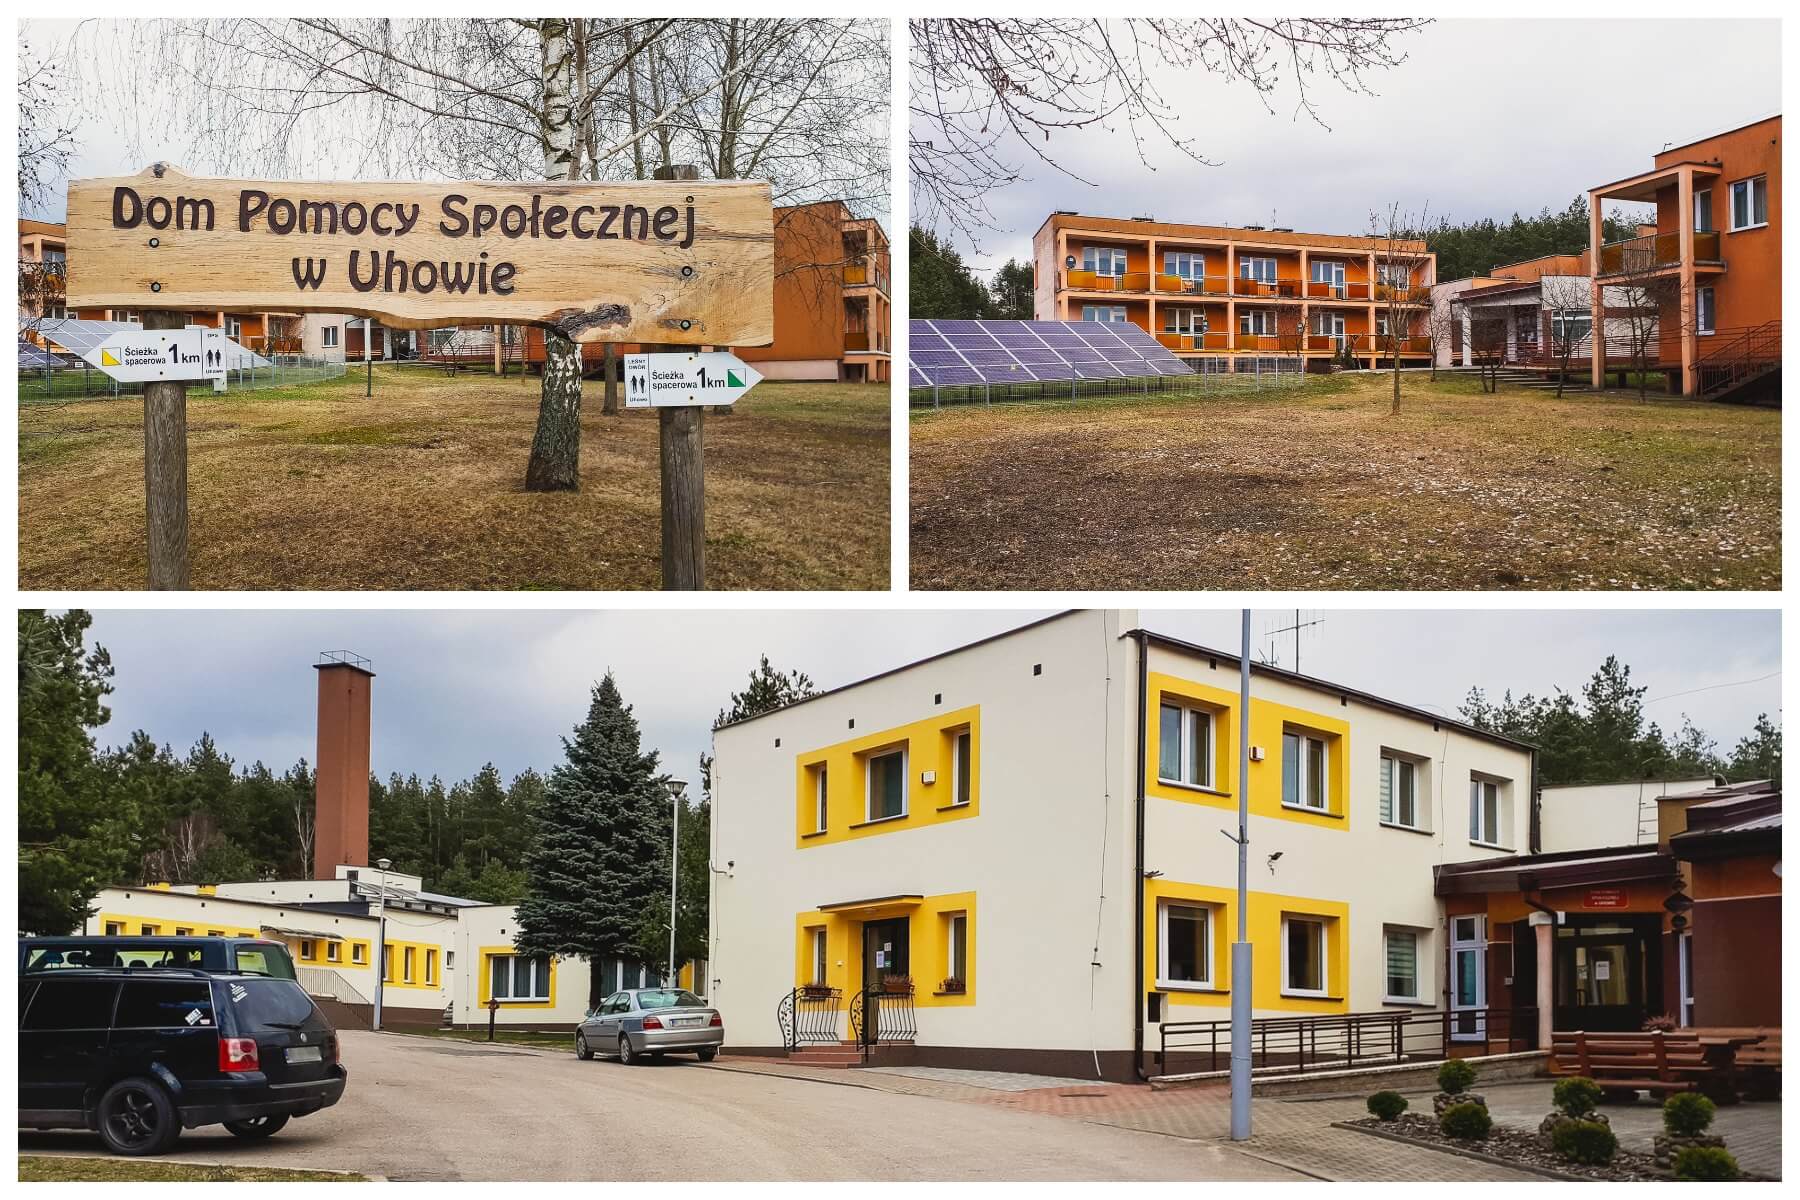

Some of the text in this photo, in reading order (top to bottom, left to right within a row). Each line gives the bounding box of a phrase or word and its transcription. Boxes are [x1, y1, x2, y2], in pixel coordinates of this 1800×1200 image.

[112, 186, 695, 249] Dom Pomocy Społecznej
[292, 250, 516, 295] w Uhowie
[124, 346, 158, 356] Ścieżka
[168, 343, 200, 364] 1 km
[125, 356, 166, 367] spacerowa
[652, 369, 684, 380] Ścieżka
[696, 367, 725, 388] 1 km
[652, 380, 698, 391] spacerowa
